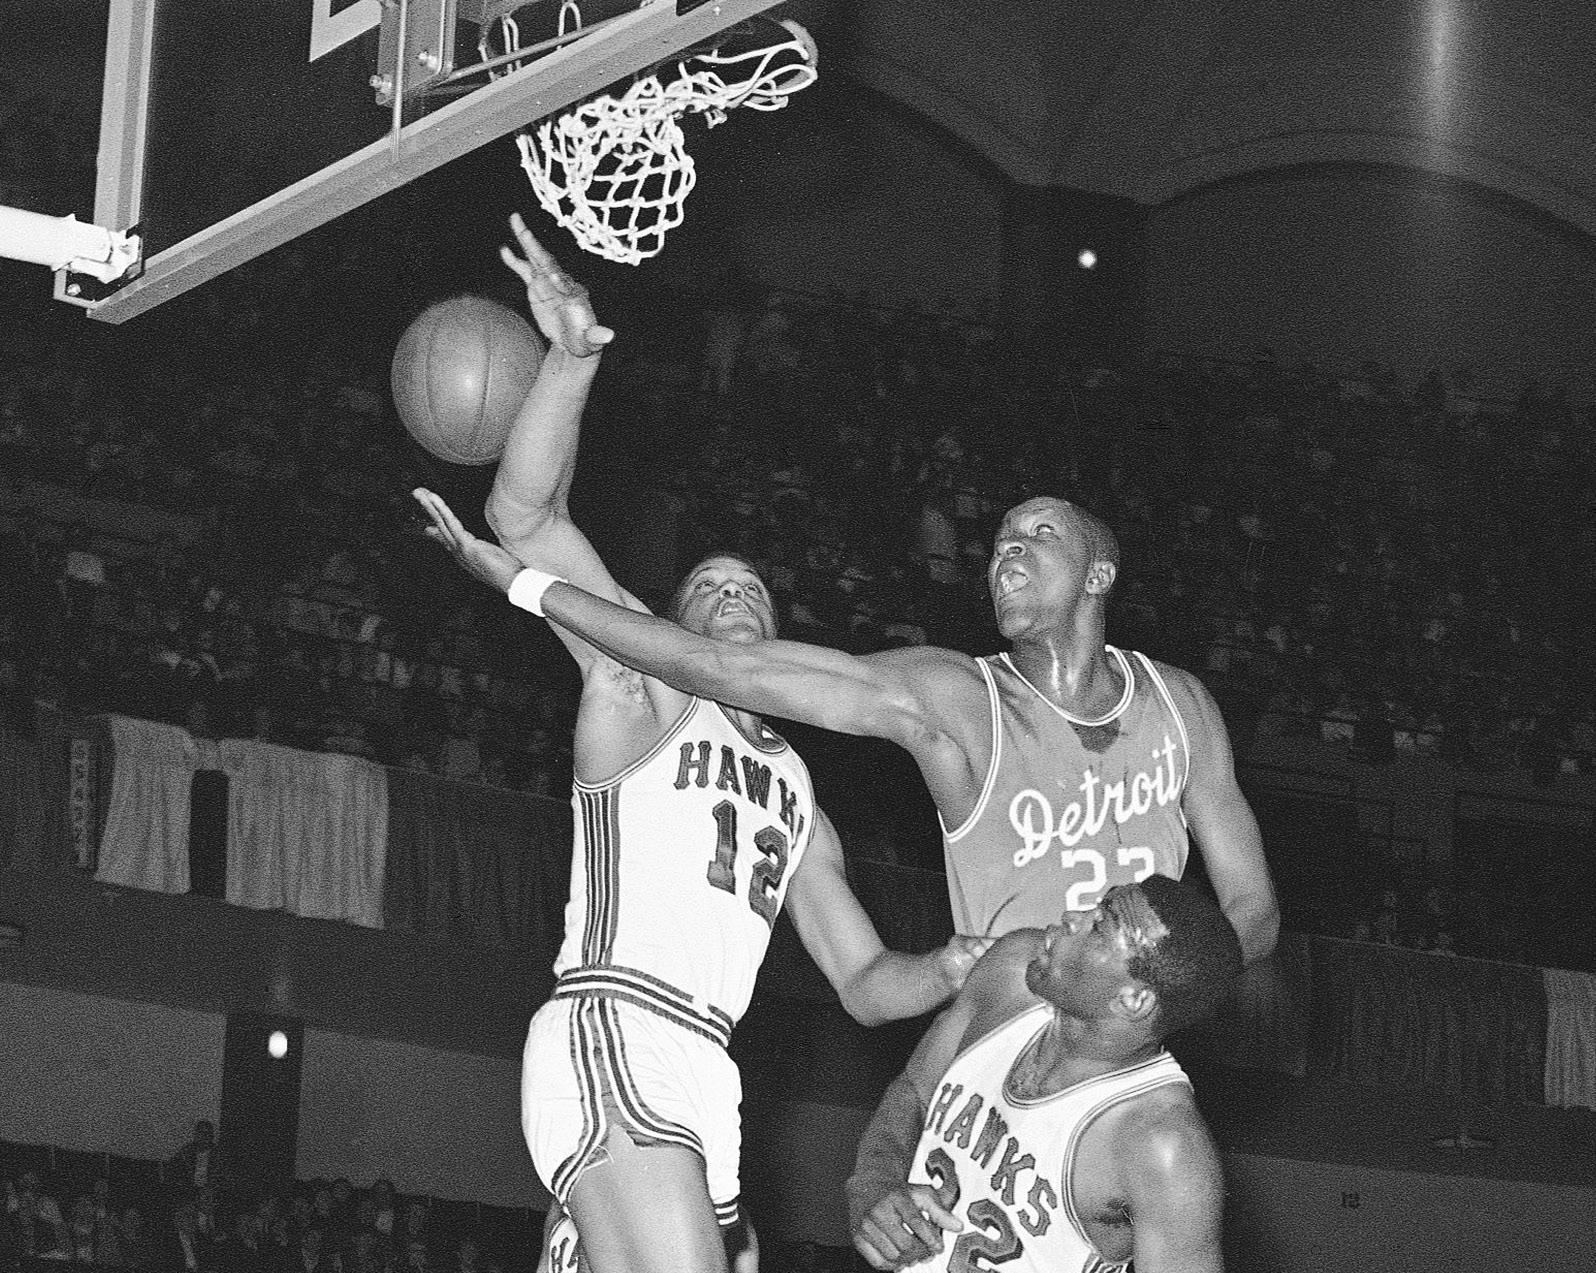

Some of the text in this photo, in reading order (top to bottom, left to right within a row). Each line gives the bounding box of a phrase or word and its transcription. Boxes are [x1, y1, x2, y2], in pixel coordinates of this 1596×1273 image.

[707, 799, 788, 930] 12
[1009, 735, 1177, 867] Detroit
[926, 1083, 1057, 1237] HAWKS
